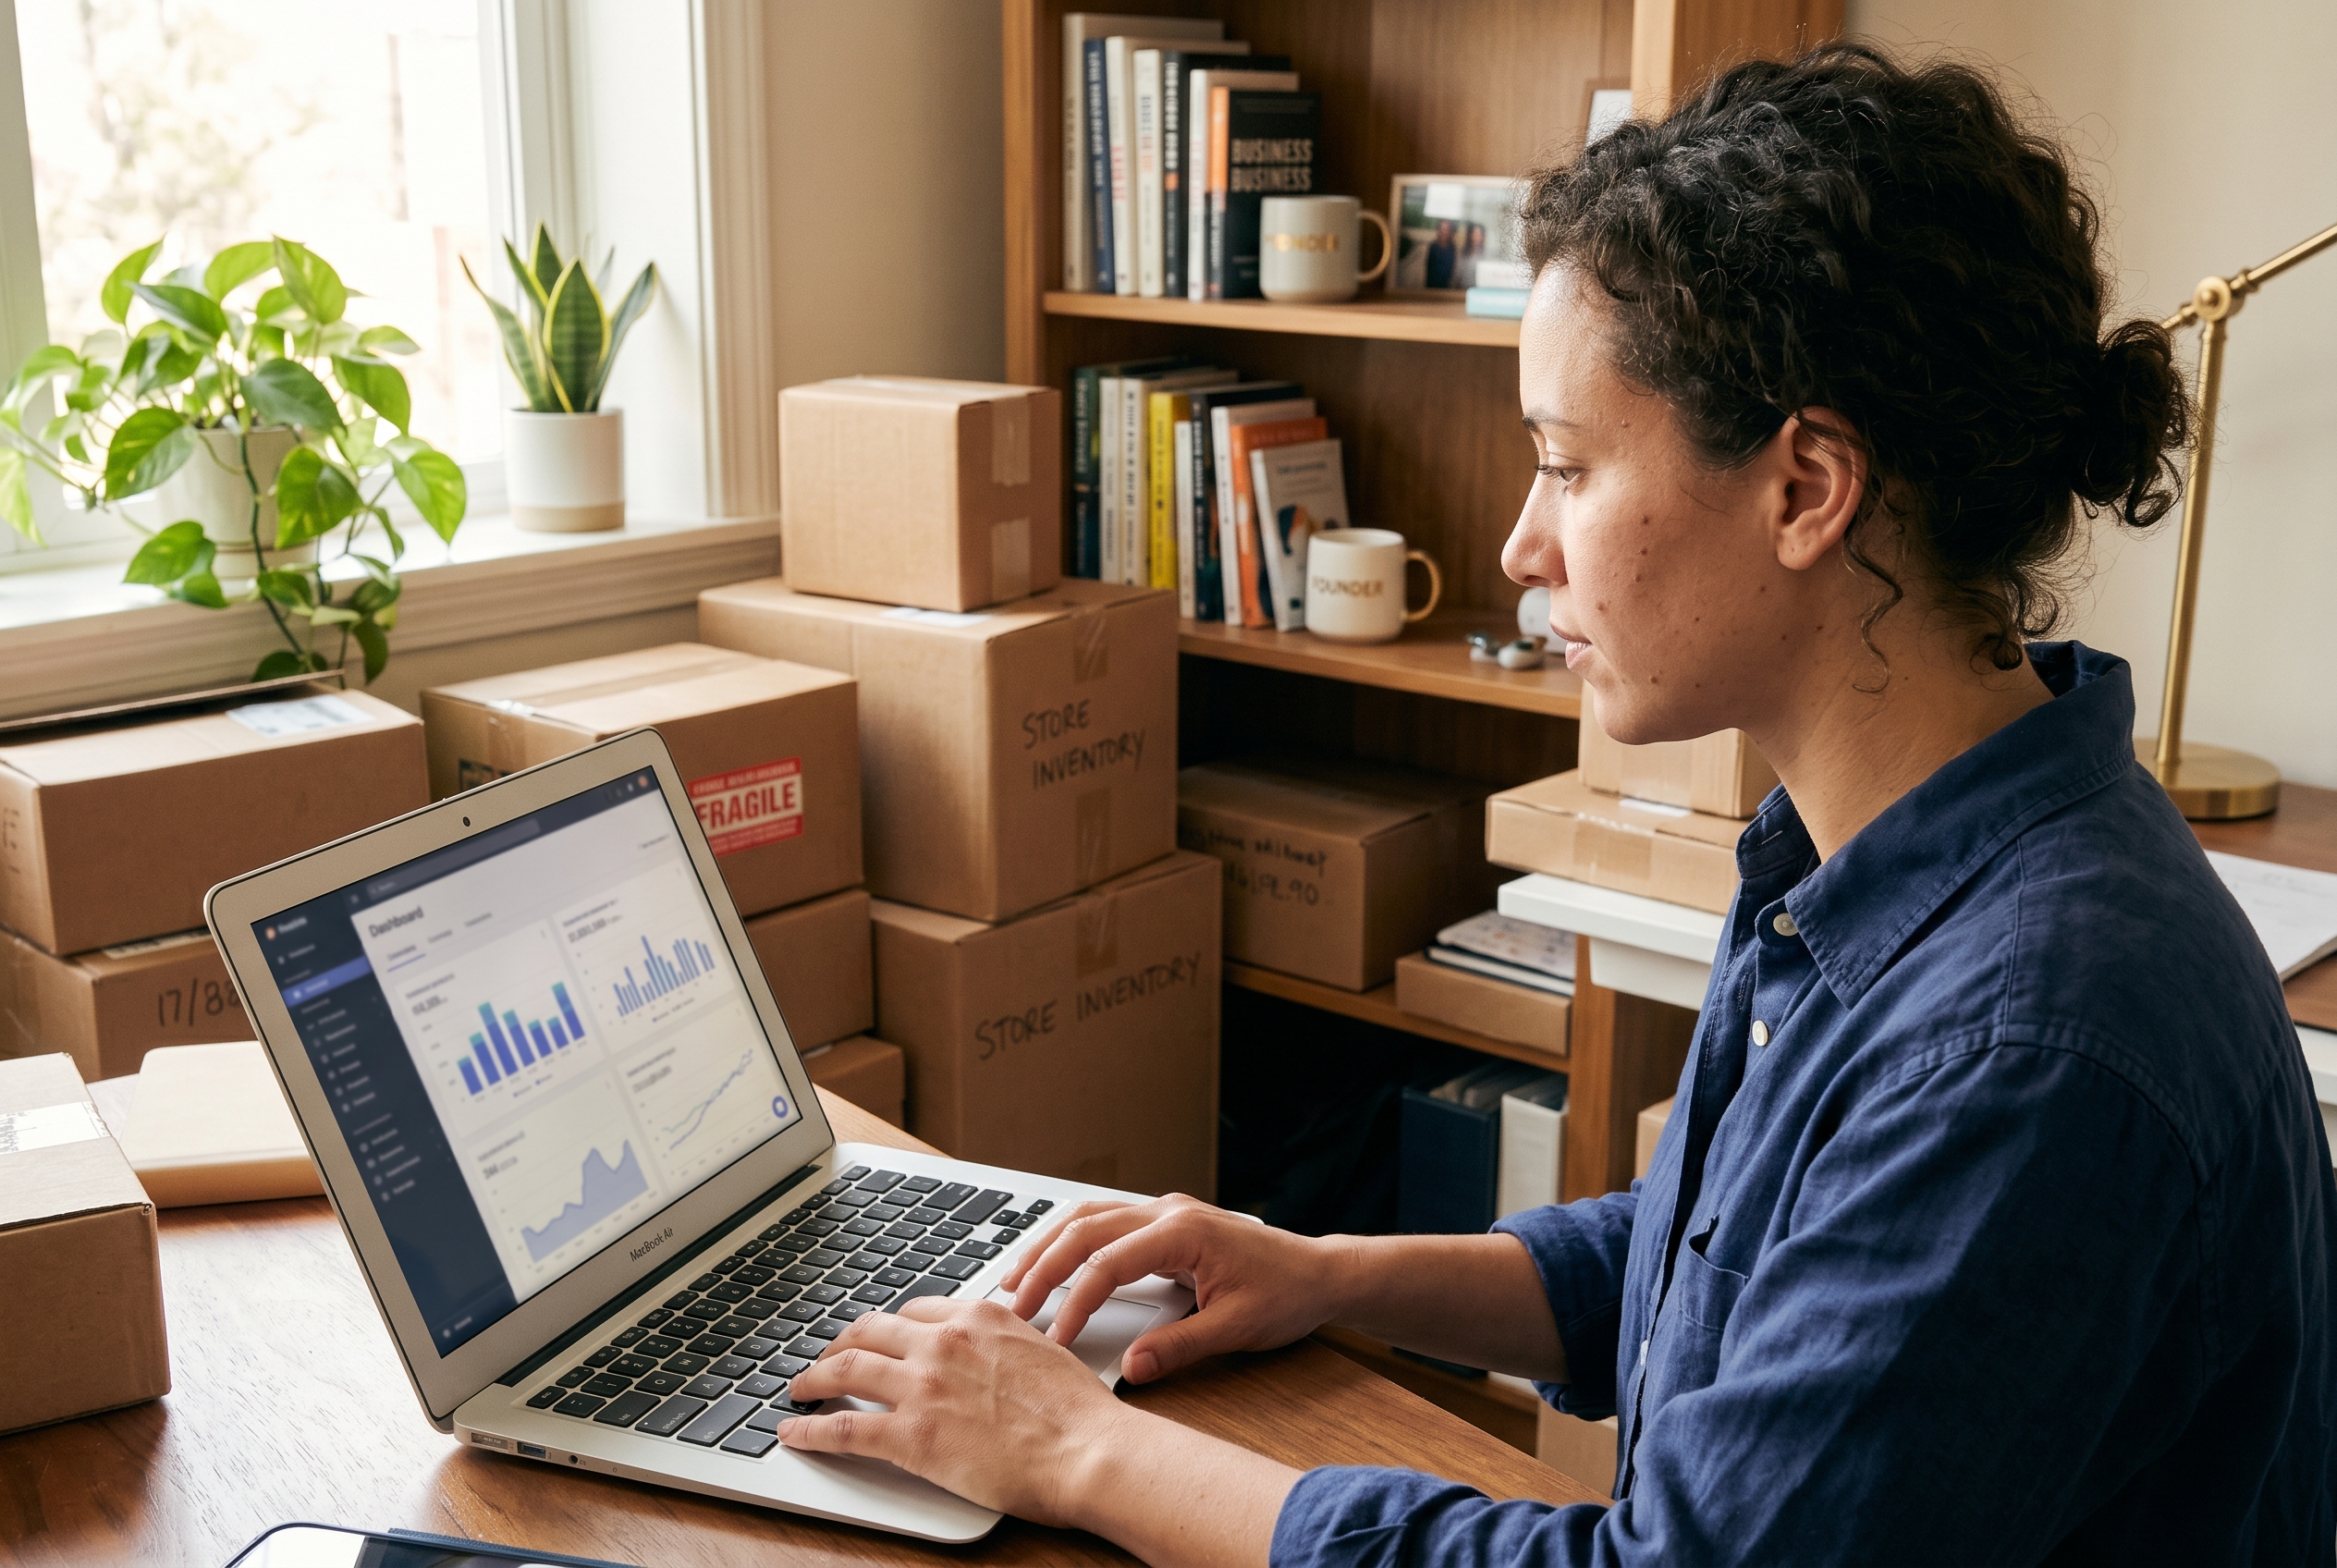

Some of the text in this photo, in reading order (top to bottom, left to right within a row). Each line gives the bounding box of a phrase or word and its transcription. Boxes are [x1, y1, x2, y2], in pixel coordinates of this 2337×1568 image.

[1230, 139, 1314, 164] BUSINESS
[1230, 166, 1313, 192] BUSINESS
[1312, 575, 1384, 598] FOUNDER
[1022, 698, 1091, 751] STORE
[1033, 729, 1146, 792] INVENTORY
[695, 781, 795, 829] FRAGILE
[368, 905, 424, 937] Dashboard
[974, 950, 1202, 1061] STORE INVENTORY
[664, 1226, 674, 1240] Air
